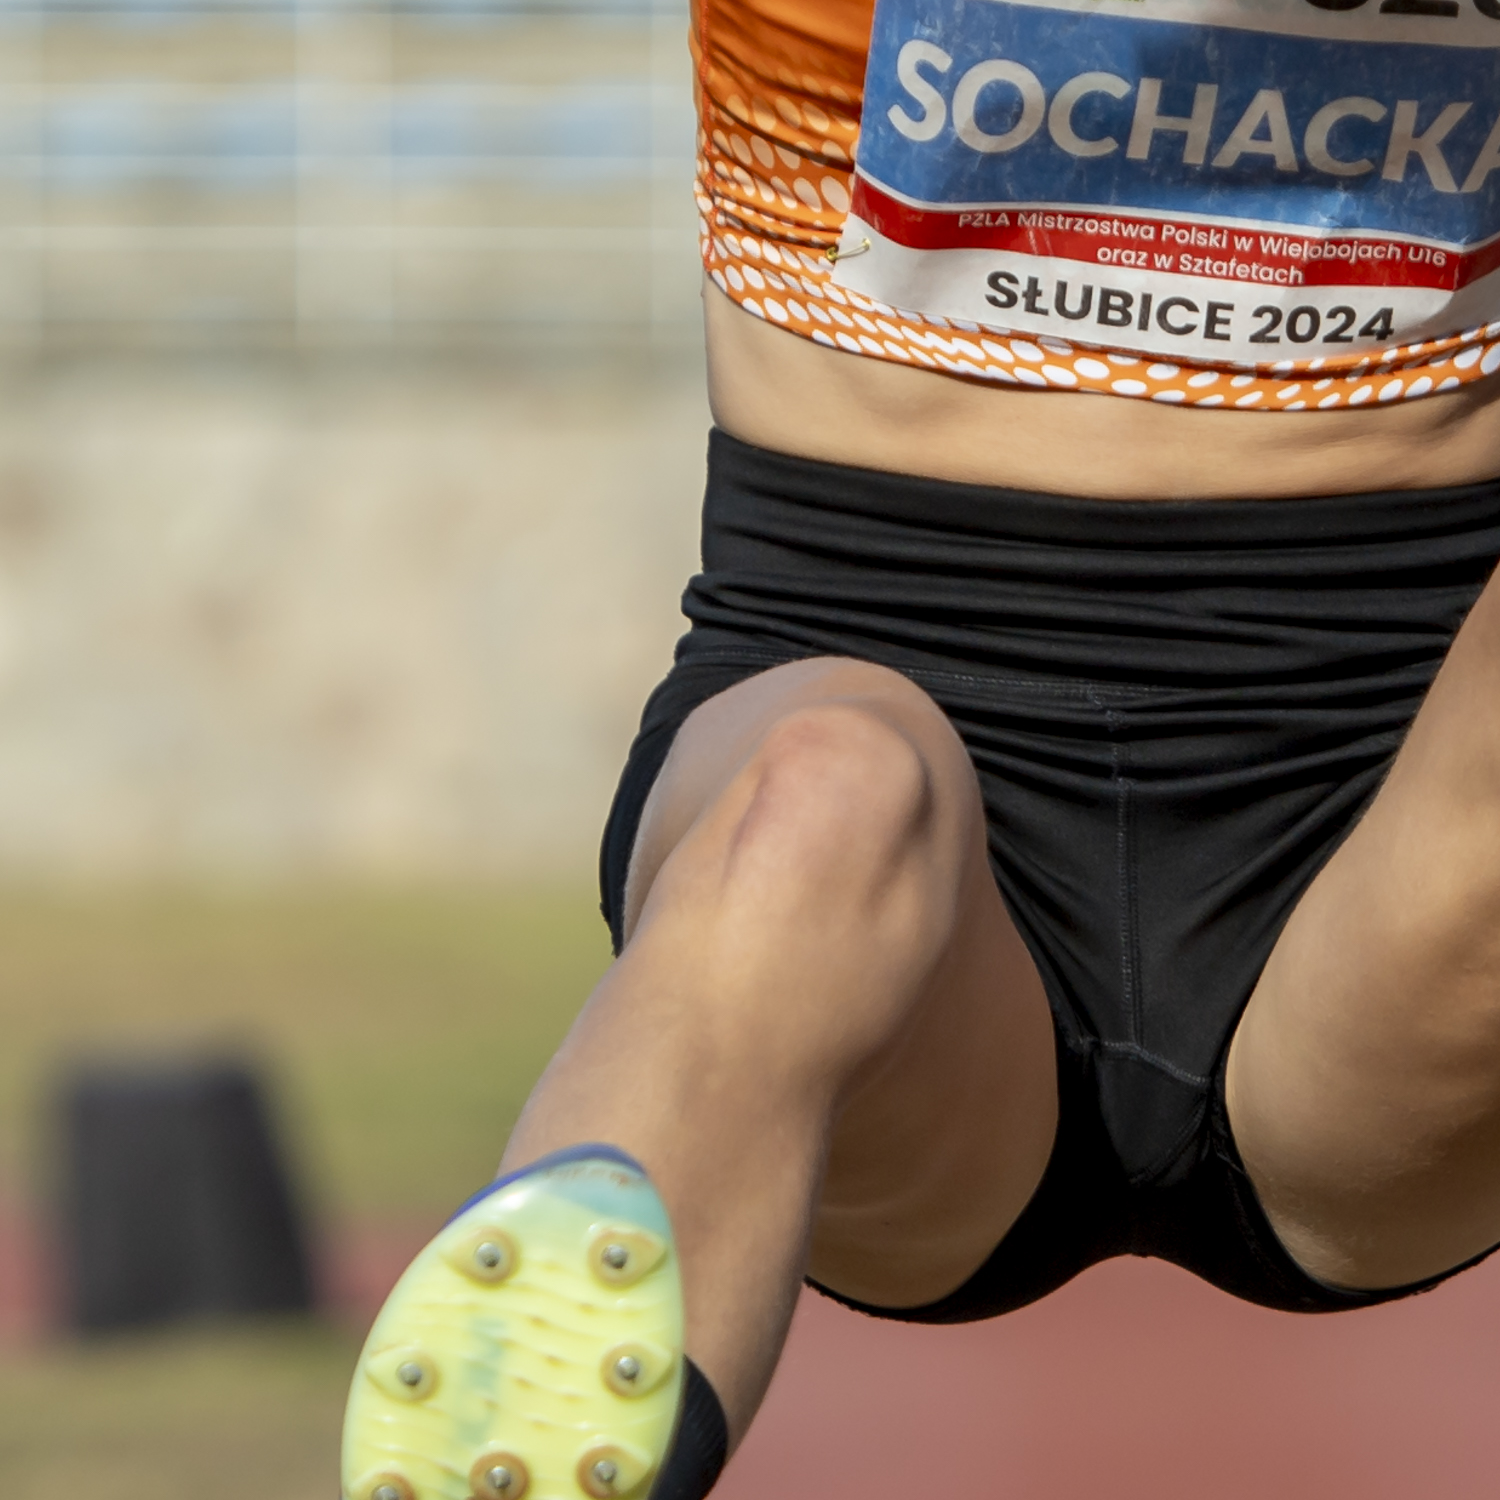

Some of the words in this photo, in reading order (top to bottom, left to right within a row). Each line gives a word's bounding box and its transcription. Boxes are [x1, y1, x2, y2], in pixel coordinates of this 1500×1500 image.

[958, 212, 1011, 228] PZLA
[1017, 211, 1155, 240] Mistrzostwa
[1161, 224, 1228, 249] Polski
[1233, 236, 1253, 251] w
[1259, 235, 1402, 264] Wielobojach
[1407, 245, 1447, 268] U16
[1096, 246, 1147, 267] oraz
[1154, 253, 1173, 269] w
[1178, 253, 1304, 285] Sztafetach
[984, 270, 1235, 341] SŁUBICE
[1248, 304, 1395, 344] 2024
